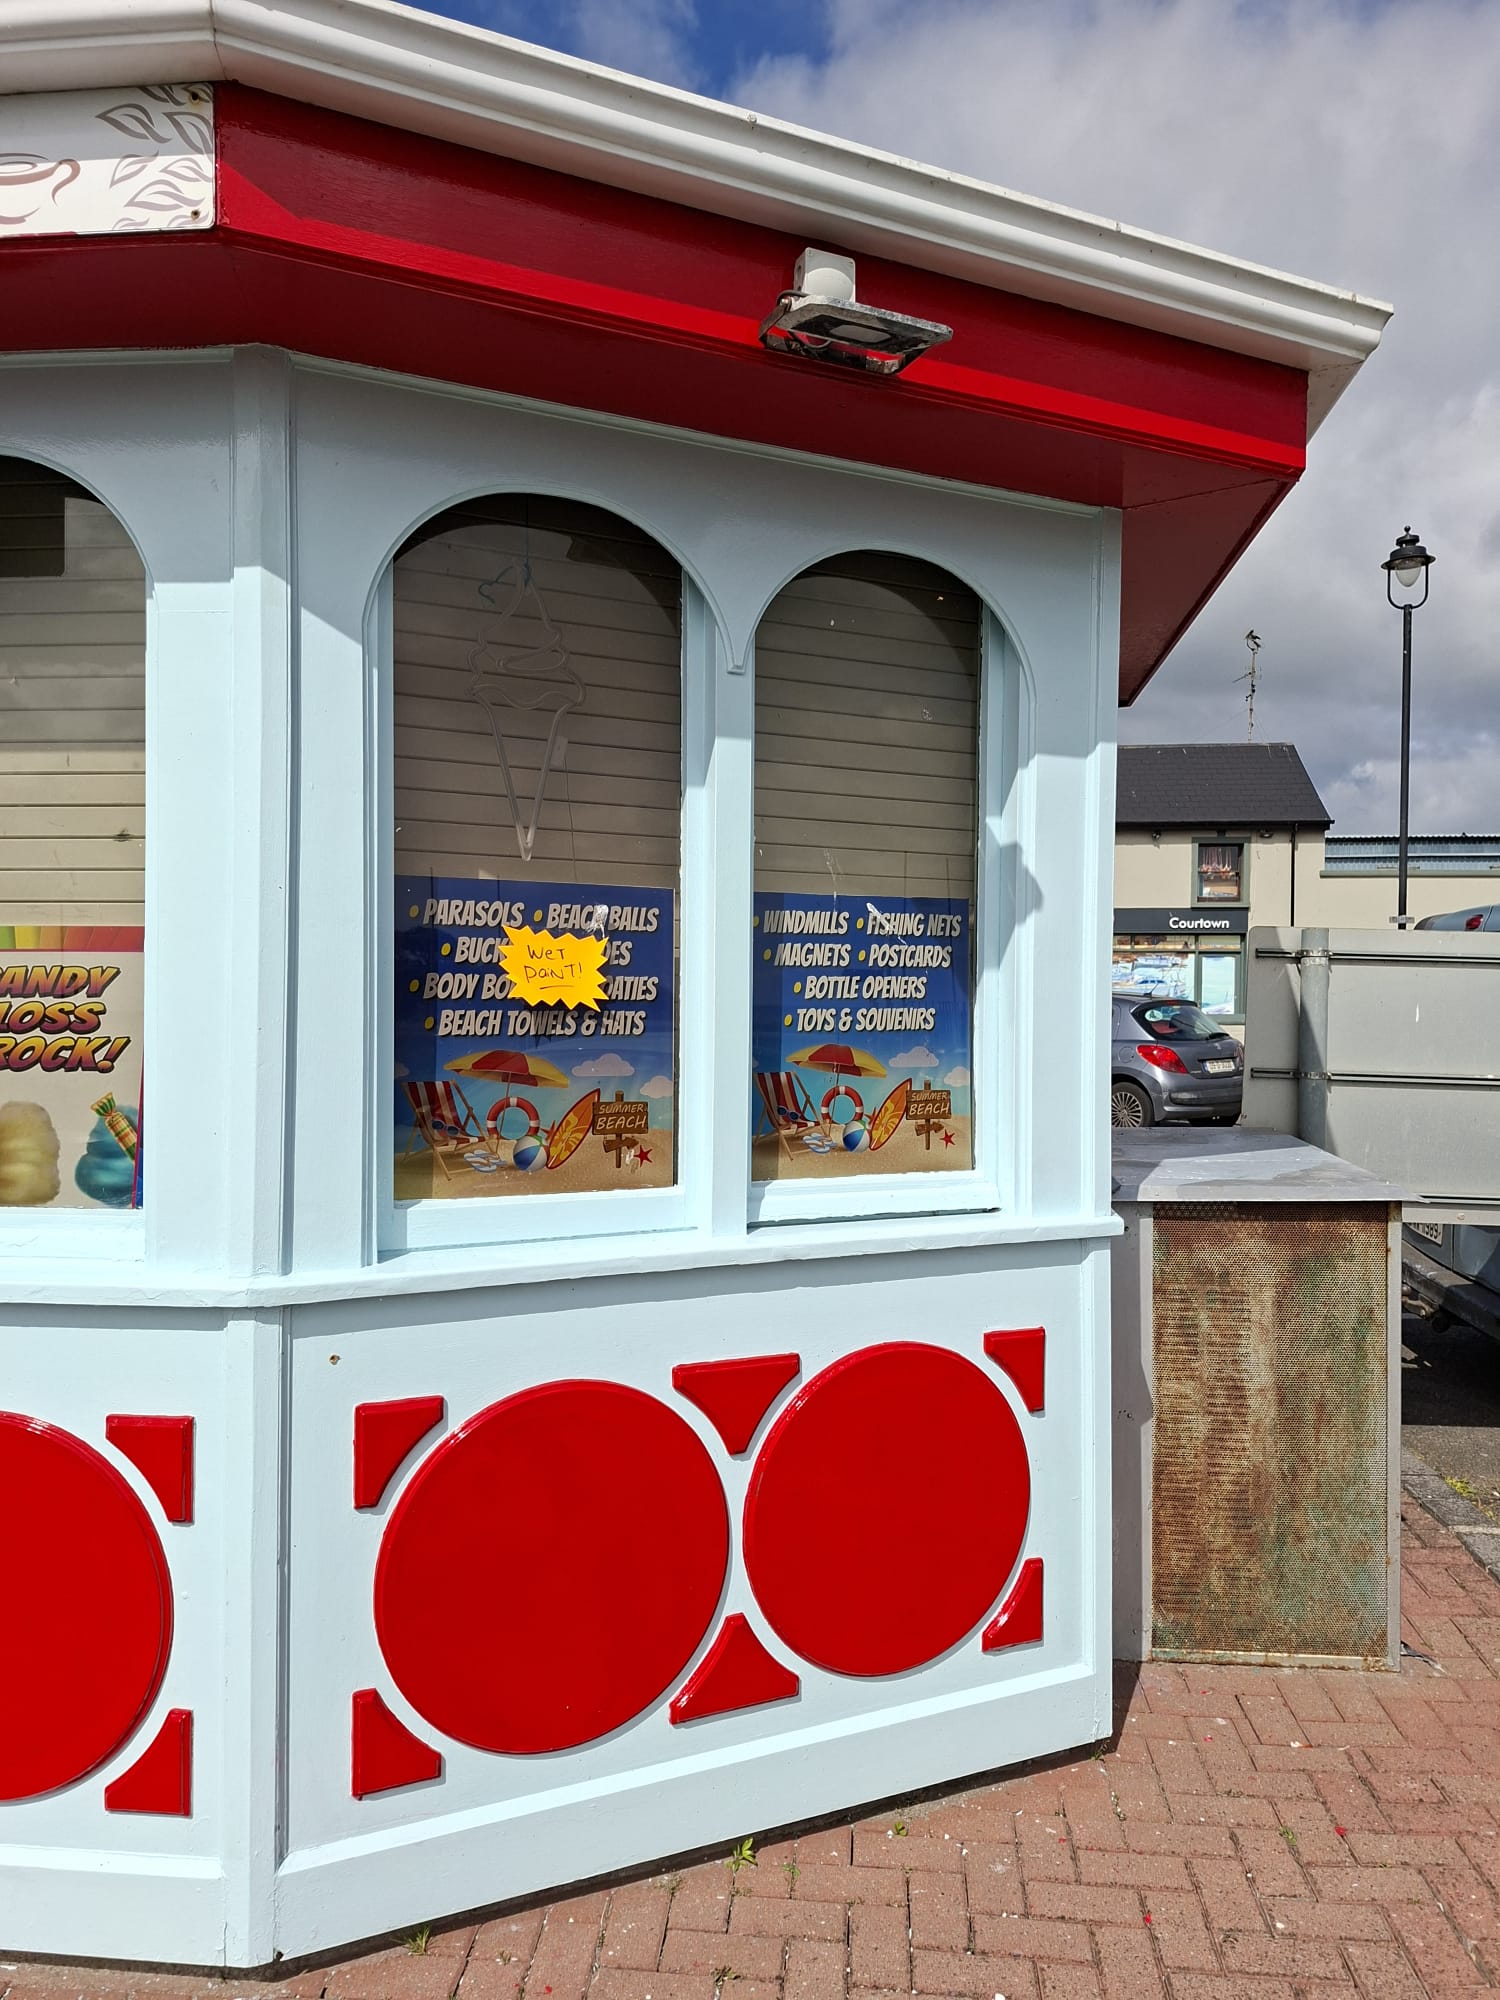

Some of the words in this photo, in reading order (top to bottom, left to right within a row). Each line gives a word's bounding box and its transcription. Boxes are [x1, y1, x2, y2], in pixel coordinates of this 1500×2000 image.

[423, 898, 525, 928] PARASOLS
[608, 906, 660, 932] BALLS
[763, 910, 849, 935] WINDMILLS
[866, 912, 925, 936] FISHING
[926, 914, 962, 936] NETS
[1169, 917, 1229, 929] Courtown
[454, 936, 516, 964] BUCK
[774, 942, 852, 966] MAGNETS
[868, 944, 952, 967] POSTCARDS
[0, 965, 121, 998] ANDY
[423, 972, 480, 999] BODY
[804, 975, 860, 999] BOTTLE
[862, 976, 928, 999] OPENERS
[438, 1009, 503, 1036] BEACH
[506, 1009, 577, 1036] TOWELS
[580, 1011, 598, 1036] &
[601, 1009, 646, 1036] HATS
[797, 1007, 836, 1032] TOYS
[838, 1008, 853, 1032] &
[855, 1007, 936, 1031] SOUVENIRS
[598, 1103, 644, 1114] SUMMER
[911, 1091, 948, 1101] SUMMER
[909, 1102, 950, 1116] BEACH
[596, 1115, 647, 1130] BEACH
